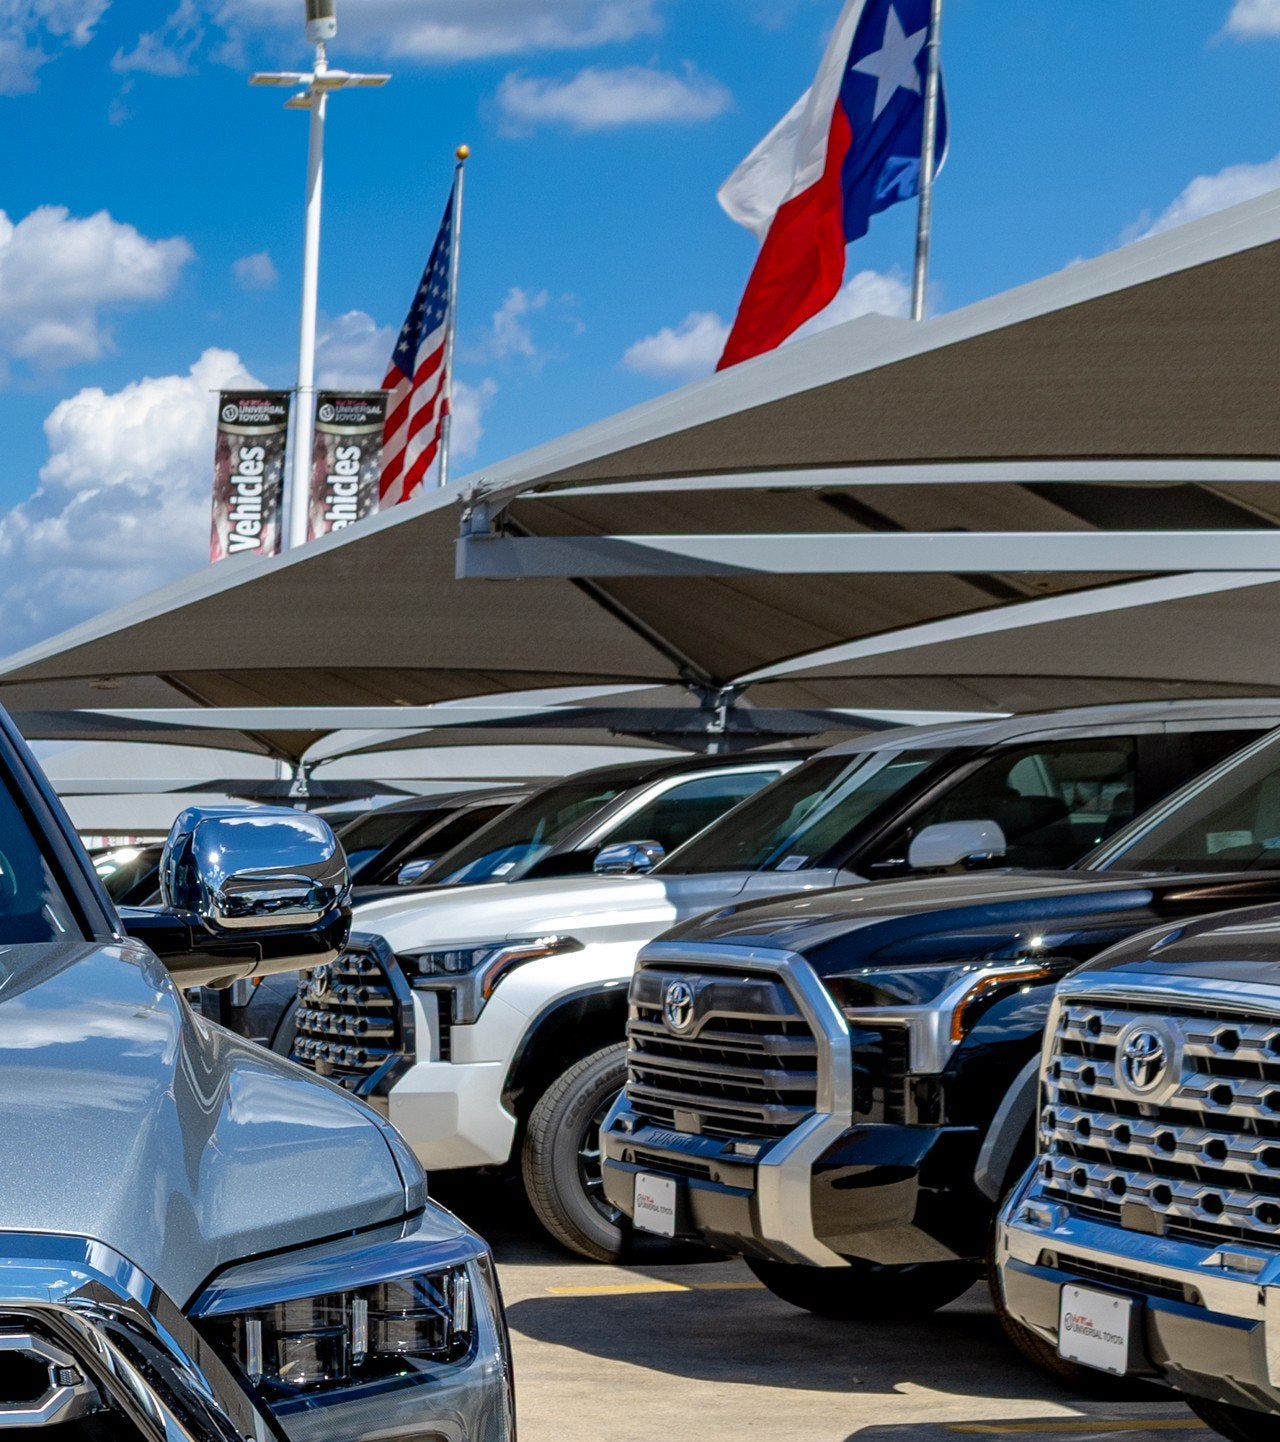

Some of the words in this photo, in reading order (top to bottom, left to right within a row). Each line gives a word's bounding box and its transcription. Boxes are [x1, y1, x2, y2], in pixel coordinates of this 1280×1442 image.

[239, 406, 285, 415] UNIVERSAL
[335, 405, 382, 414] UNIVERSAL
[228, 445, 266, 554] Vehicles
[325, 445, 362, 532] ehicles
